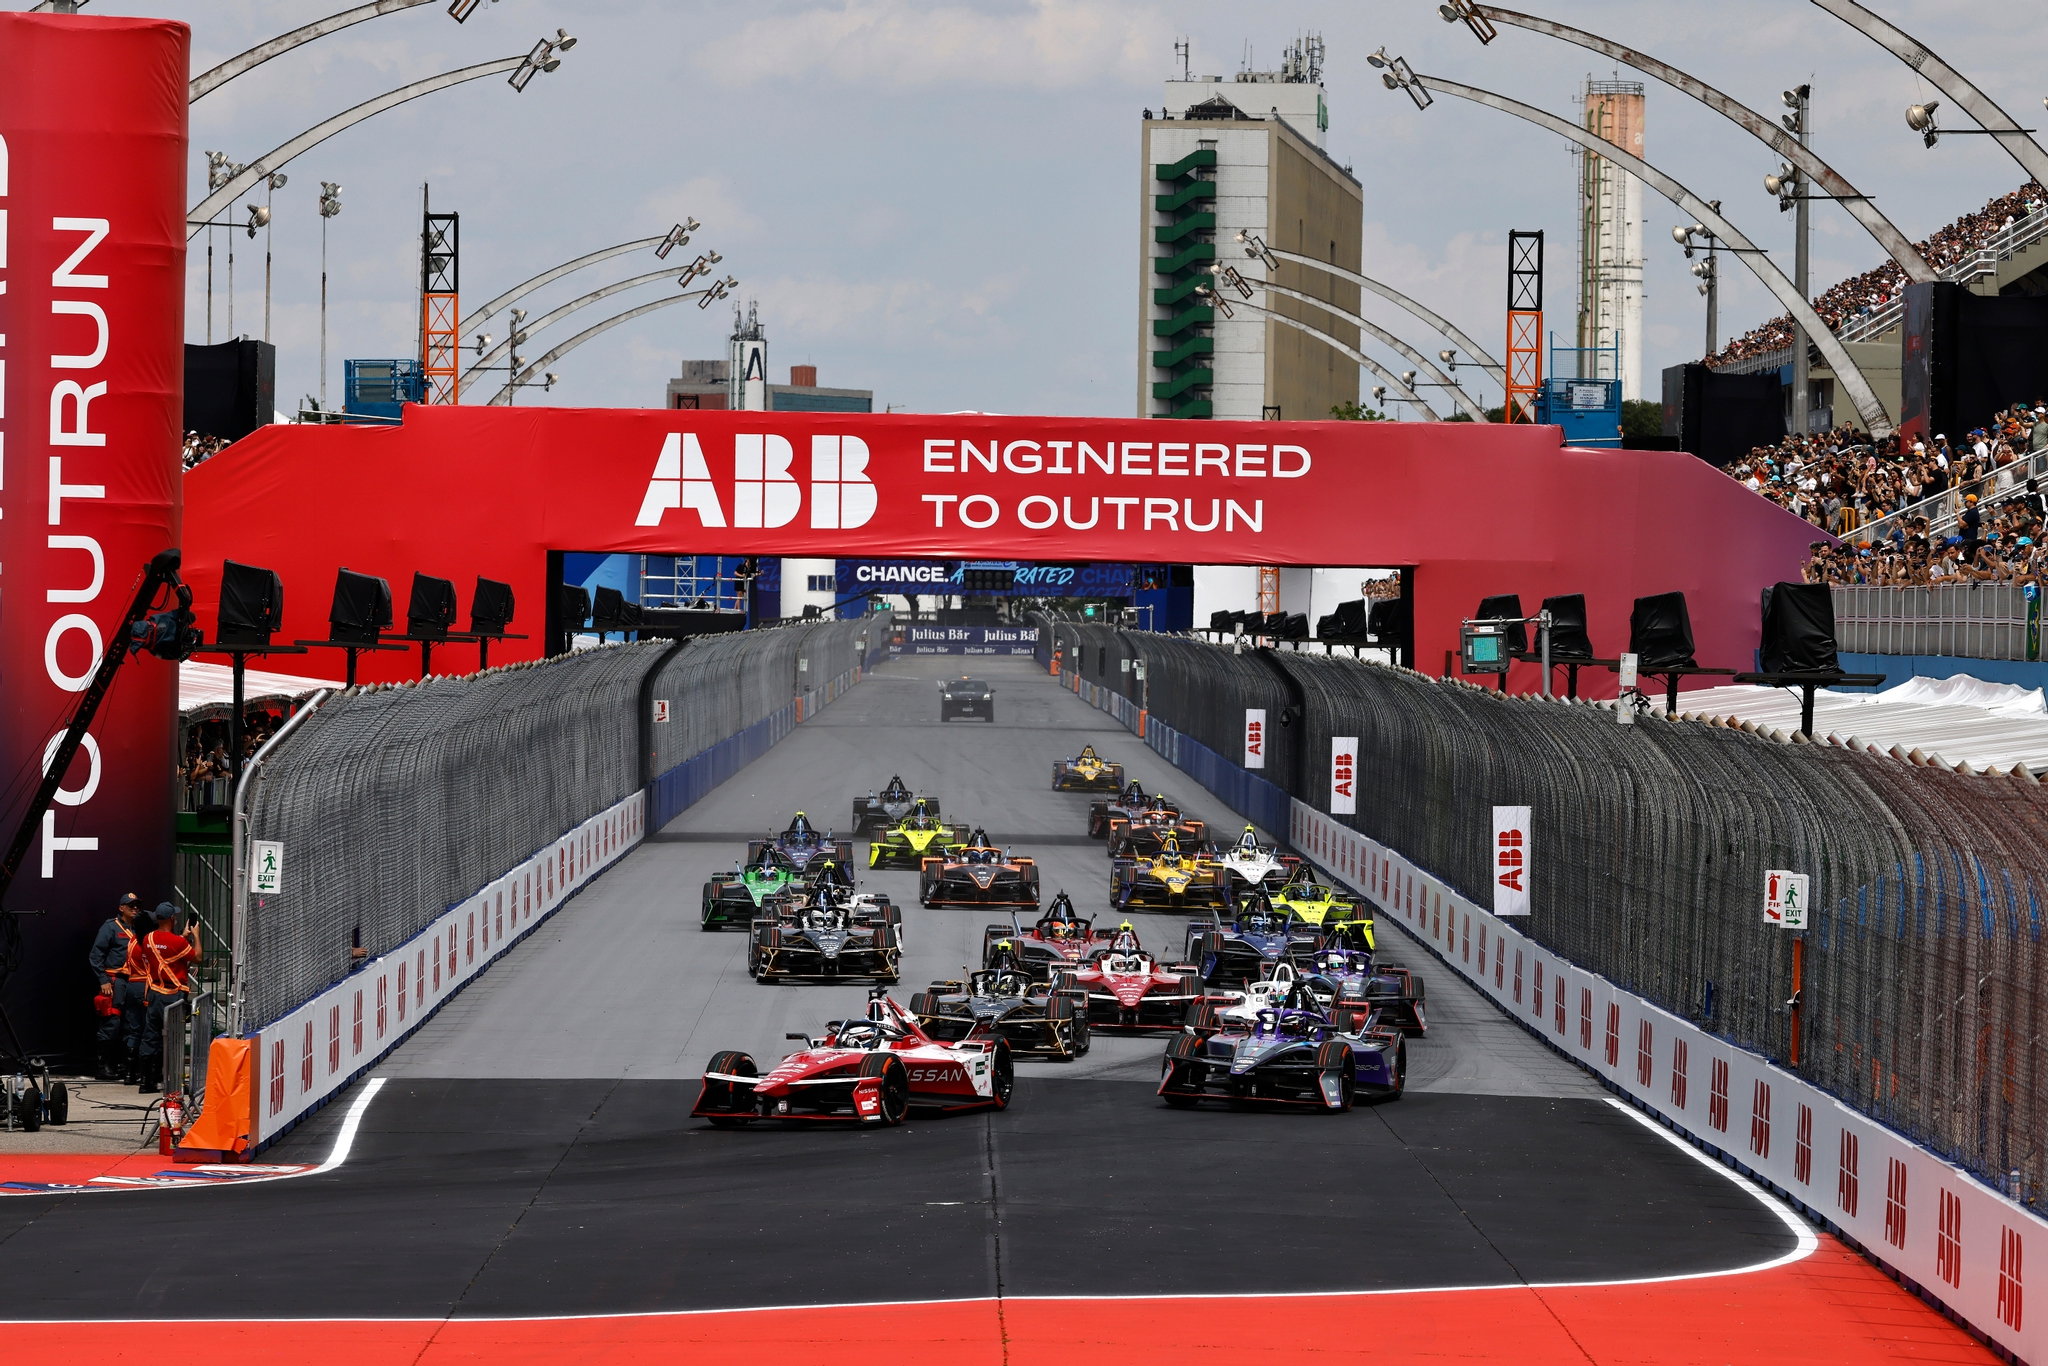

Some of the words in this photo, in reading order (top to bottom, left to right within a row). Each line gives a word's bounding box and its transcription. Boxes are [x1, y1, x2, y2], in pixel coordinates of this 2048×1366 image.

[44, 217, 110, 692] OUTRUN
[634, 432, 878, 528] ABB
[923, 439, 1312, 478] ENGINEERED
[922, 495, 1000, 529] TO
[1017, 496, 1263, 532] OUTRUN
[856, 565, 949, 583] CHANGE.
[912, 629, 945, 641] Julius
[984, 630, 1017, 643] Julius
[1248, 721, 1262, 755] ABB
[42, 727, 102, 878] TO
[1335, 753, 1353, 798] ABB
[257, 874, 275, 882] EXIT
[1498, 828, 1523, 892] ABB
[1785, 909, 1802, 917] EXIT
[1750, 1079, 1771, 1159] ABB
[1794, 1102, 1812, 1186] ABB
[1838, 1128, 1859, 1218] ABB
[1885, 1156, 1907, 1250] ABB
[1936, 1187, 1961, 1289] ABB
[1996, 1225, 2023, 1333] ABB
